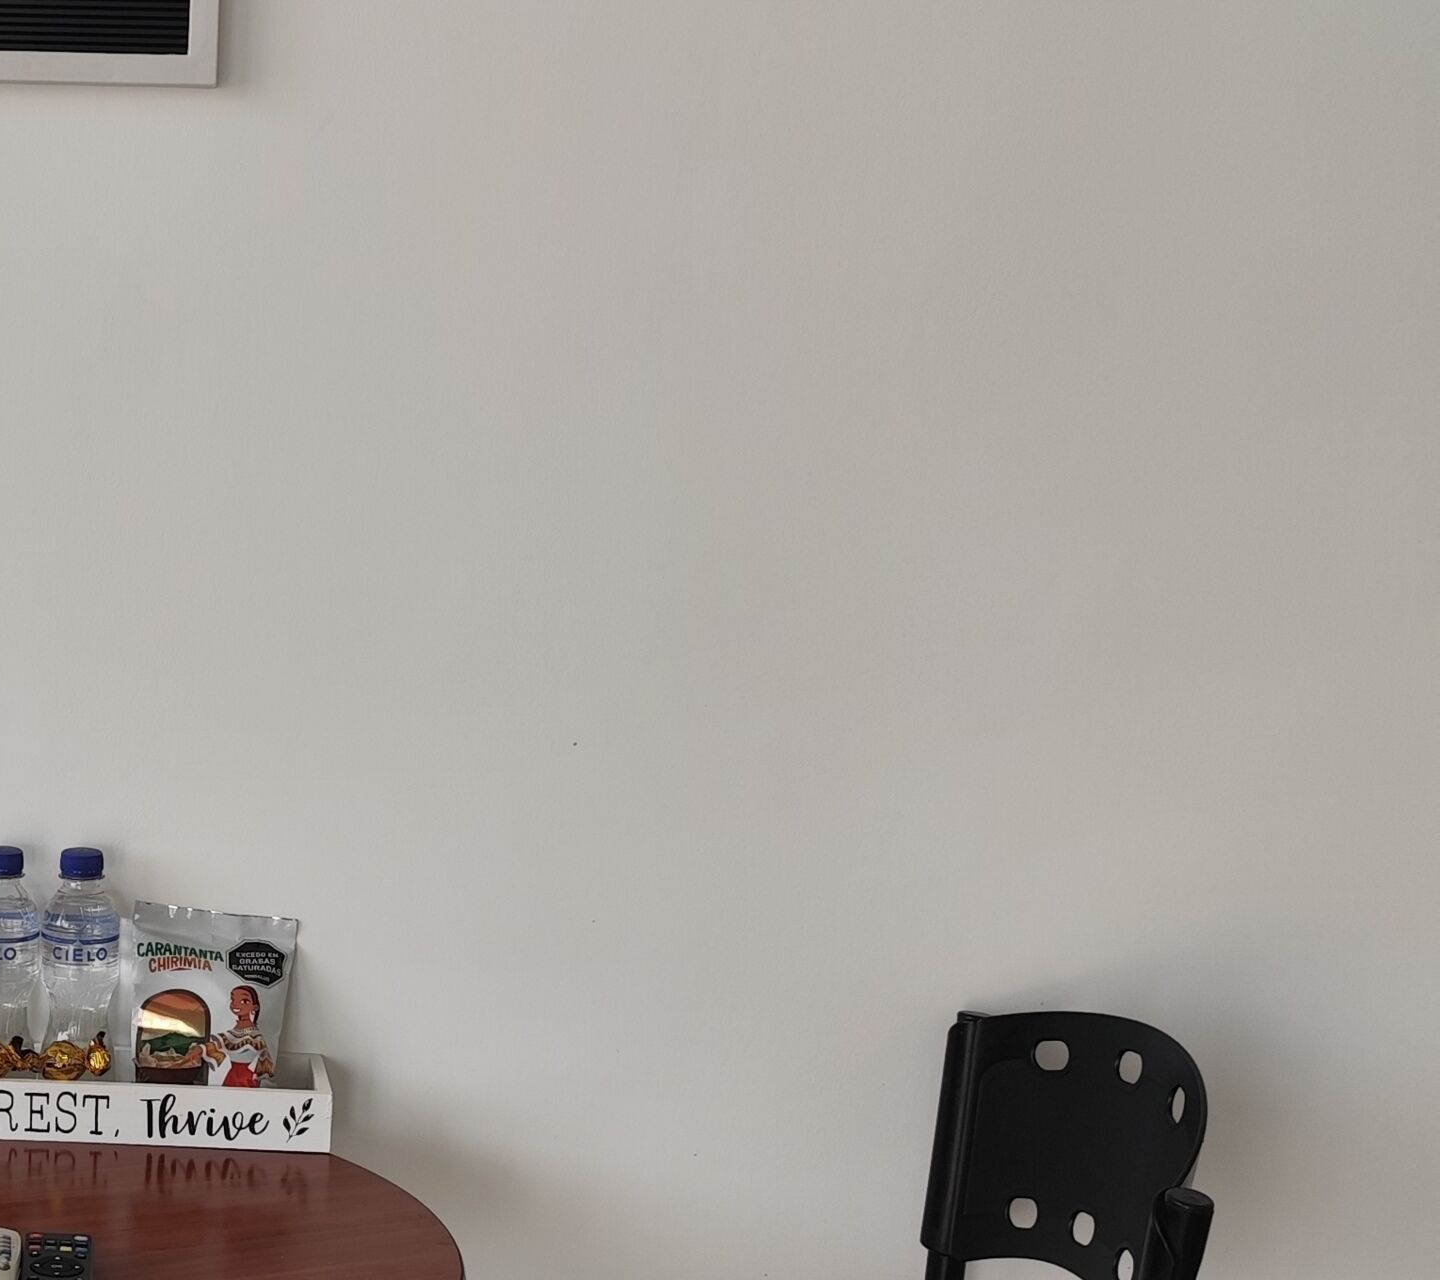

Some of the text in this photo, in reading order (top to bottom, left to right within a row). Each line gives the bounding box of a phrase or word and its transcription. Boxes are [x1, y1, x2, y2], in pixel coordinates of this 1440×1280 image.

[52, 946, 108, 962] CIELO
[137, 942, 224, 962] CARANTANTA
[148, 955, 213, 973] CHIRIMIA
[139, 1093, 270, 1141] Thrive
